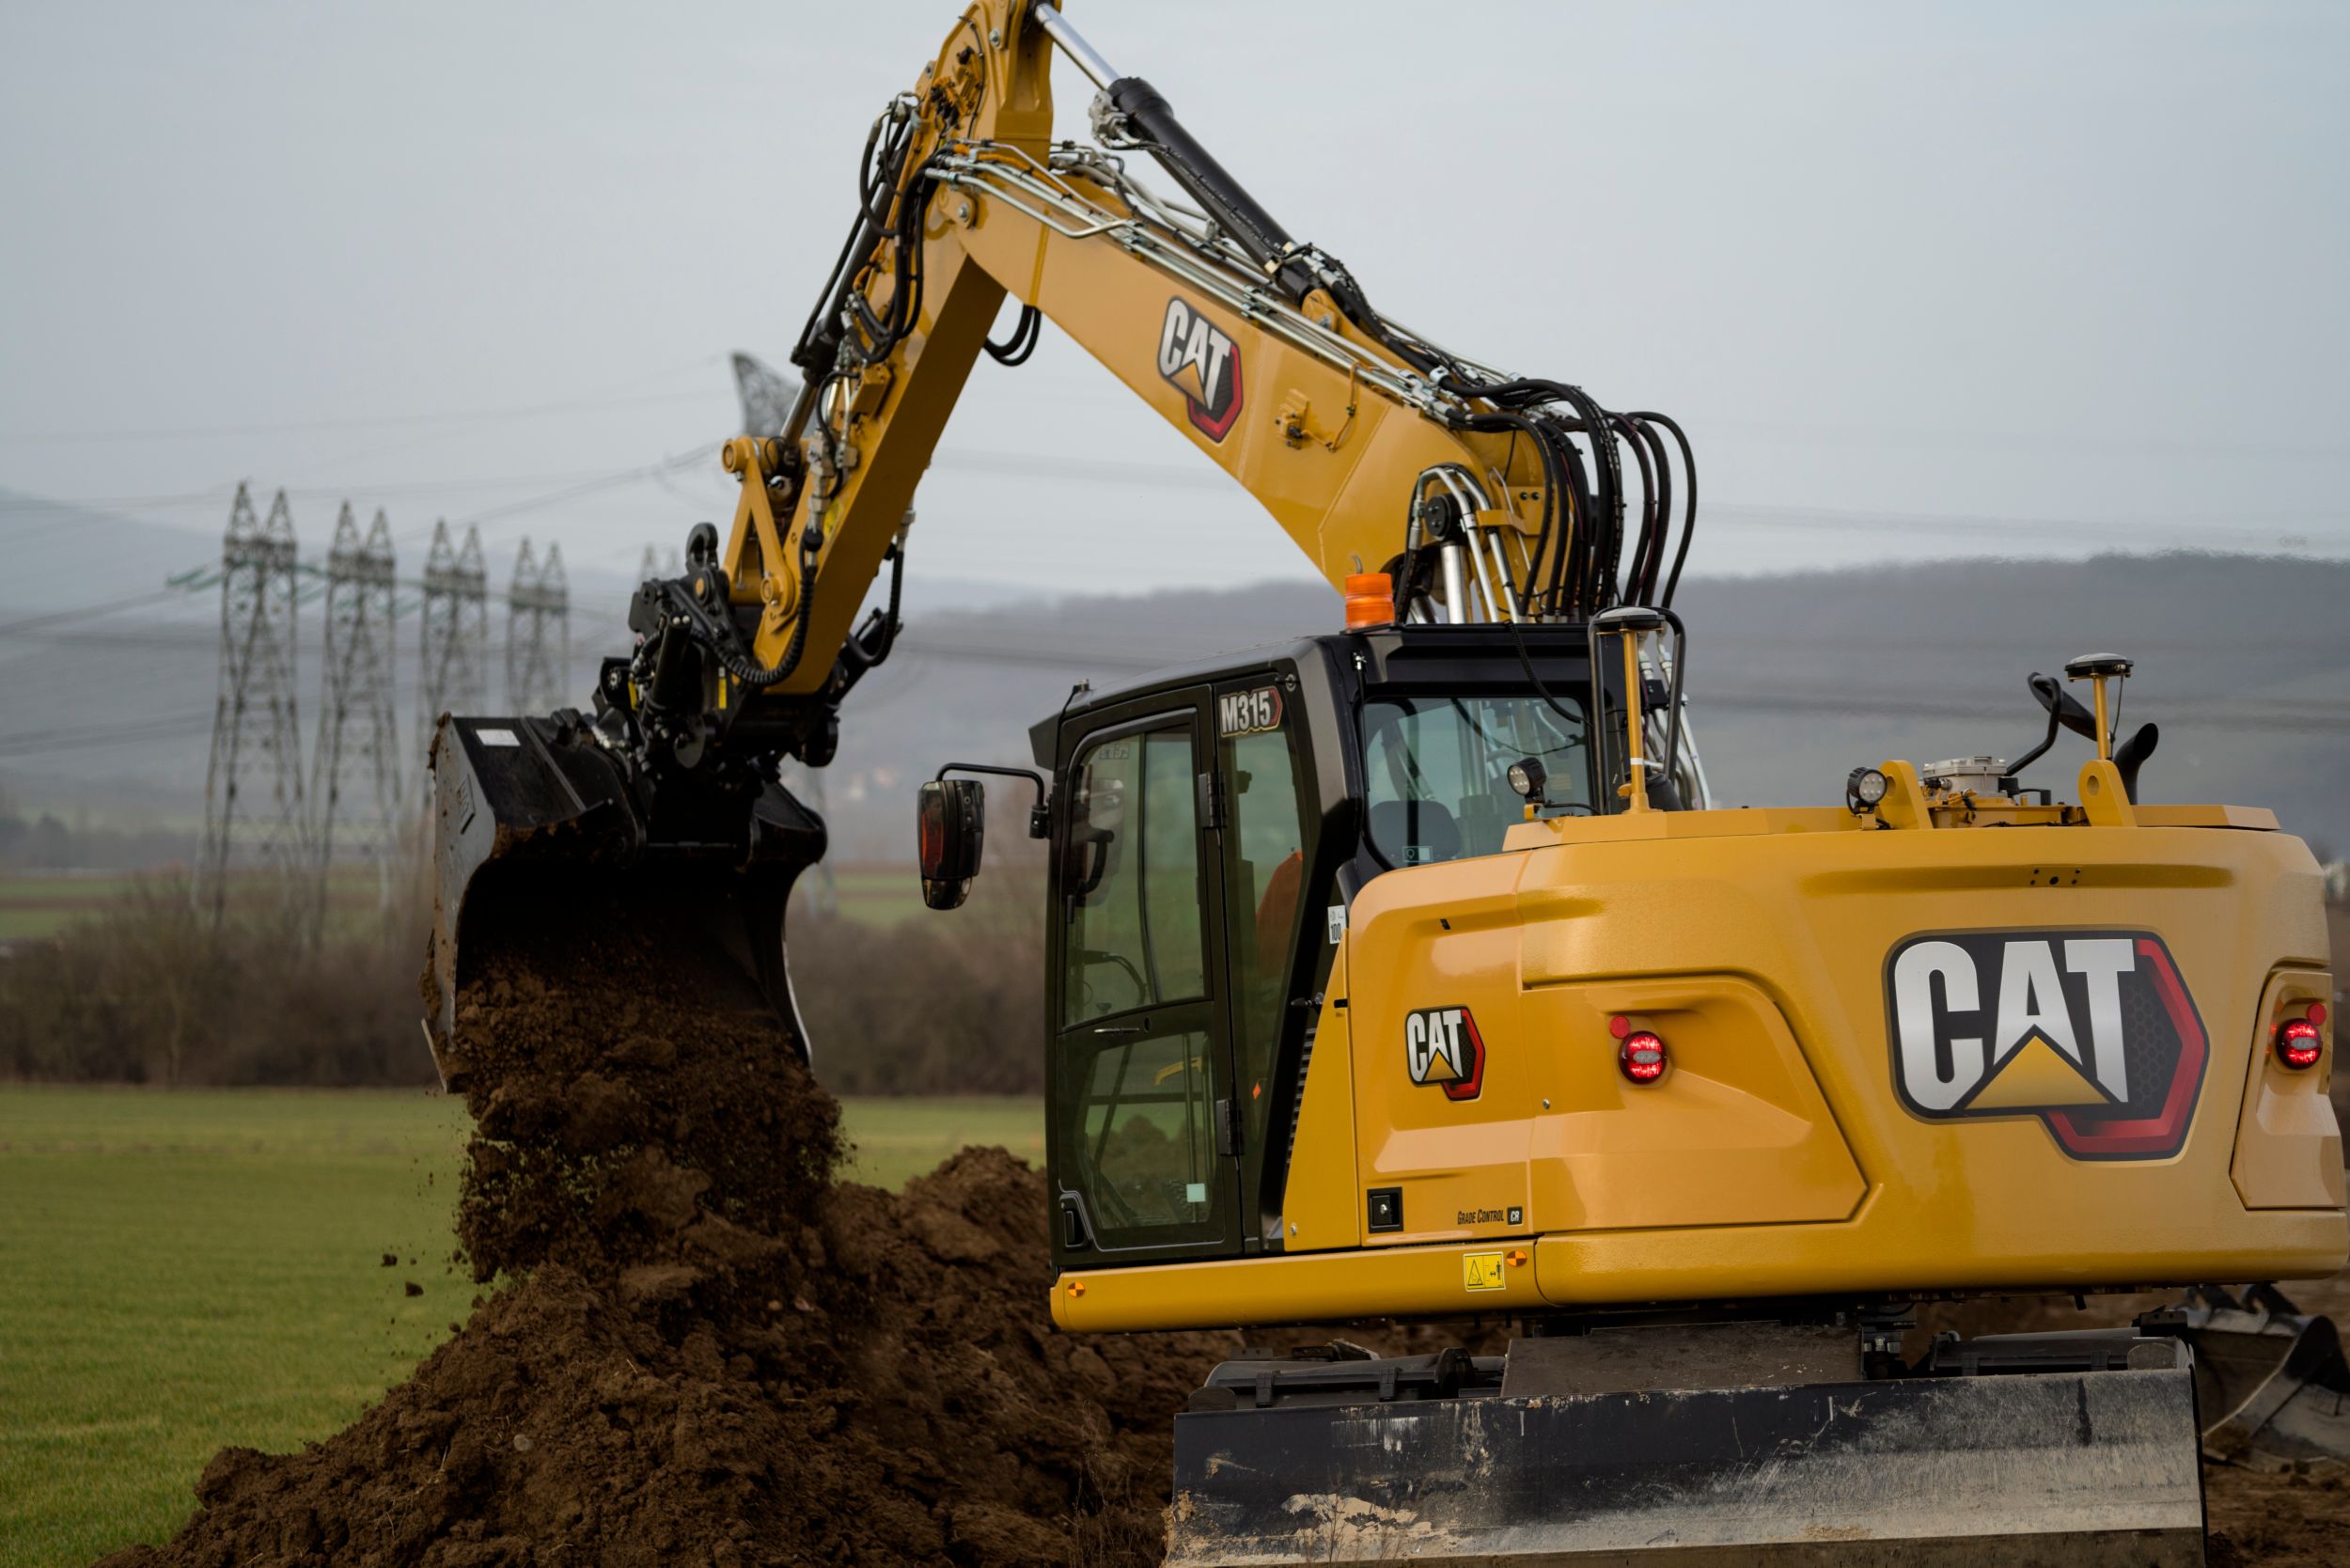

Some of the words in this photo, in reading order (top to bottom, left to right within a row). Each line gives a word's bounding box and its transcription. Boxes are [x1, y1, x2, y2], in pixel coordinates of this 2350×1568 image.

[1159, 299, 1231, 411] CAT
[1221, 690, 1271, 733] M315
[1406, 1009, 1464, 1082] CAT
[1894, 938, 2136, 1110] CAT
[1510, 1210, 1520, 1222] CR
